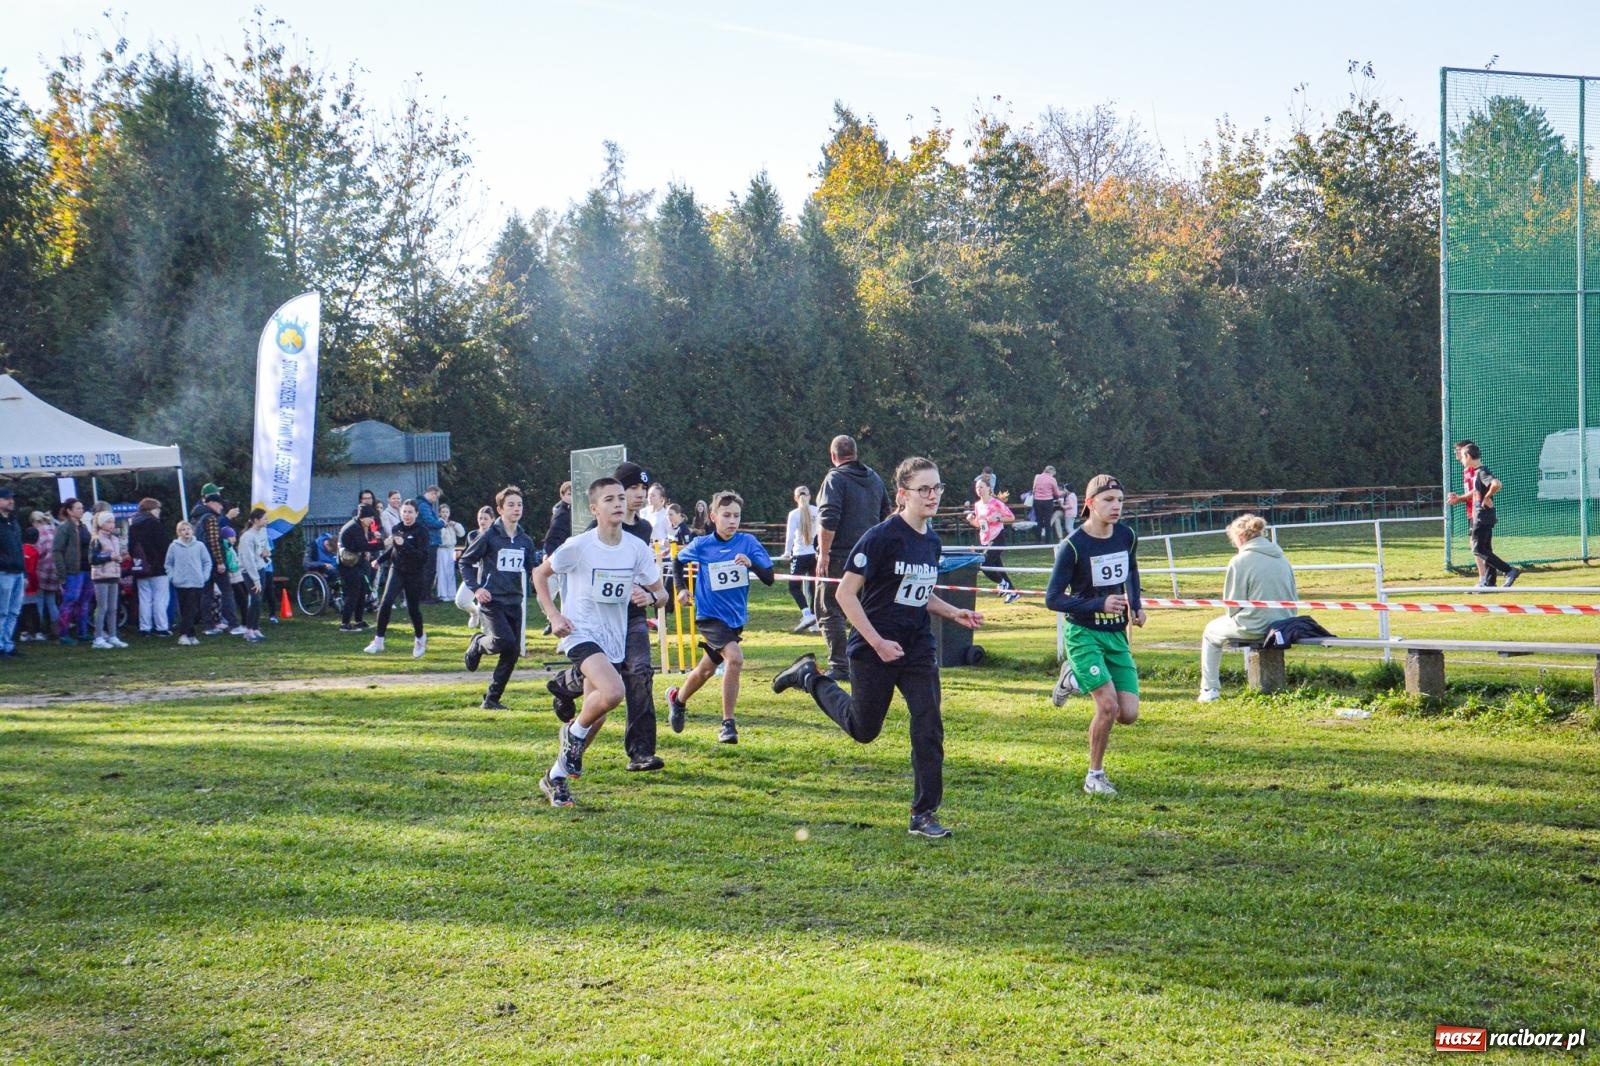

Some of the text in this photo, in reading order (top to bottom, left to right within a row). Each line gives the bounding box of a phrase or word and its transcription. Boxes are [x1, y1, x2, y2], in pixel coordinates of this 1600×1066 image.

[280, 359, 298, 410] STOWARZYSZENIE
[277, 440, 293, 451] DLA
[12, 455, 31, 468] DLA
[39, 454, 85, 468] LEPSZEGO
[95, 453, 122, 466] JUTRA
[274, 453, 292, 484] LEPSZEGO
[272, 485, 289, 505] JUTRA
[500, 556, 523, 568] 117
[718, 570, 740, 585] 93
[1101, 563, 1123, 580] 95
[602, 582, 625, 598] 86
